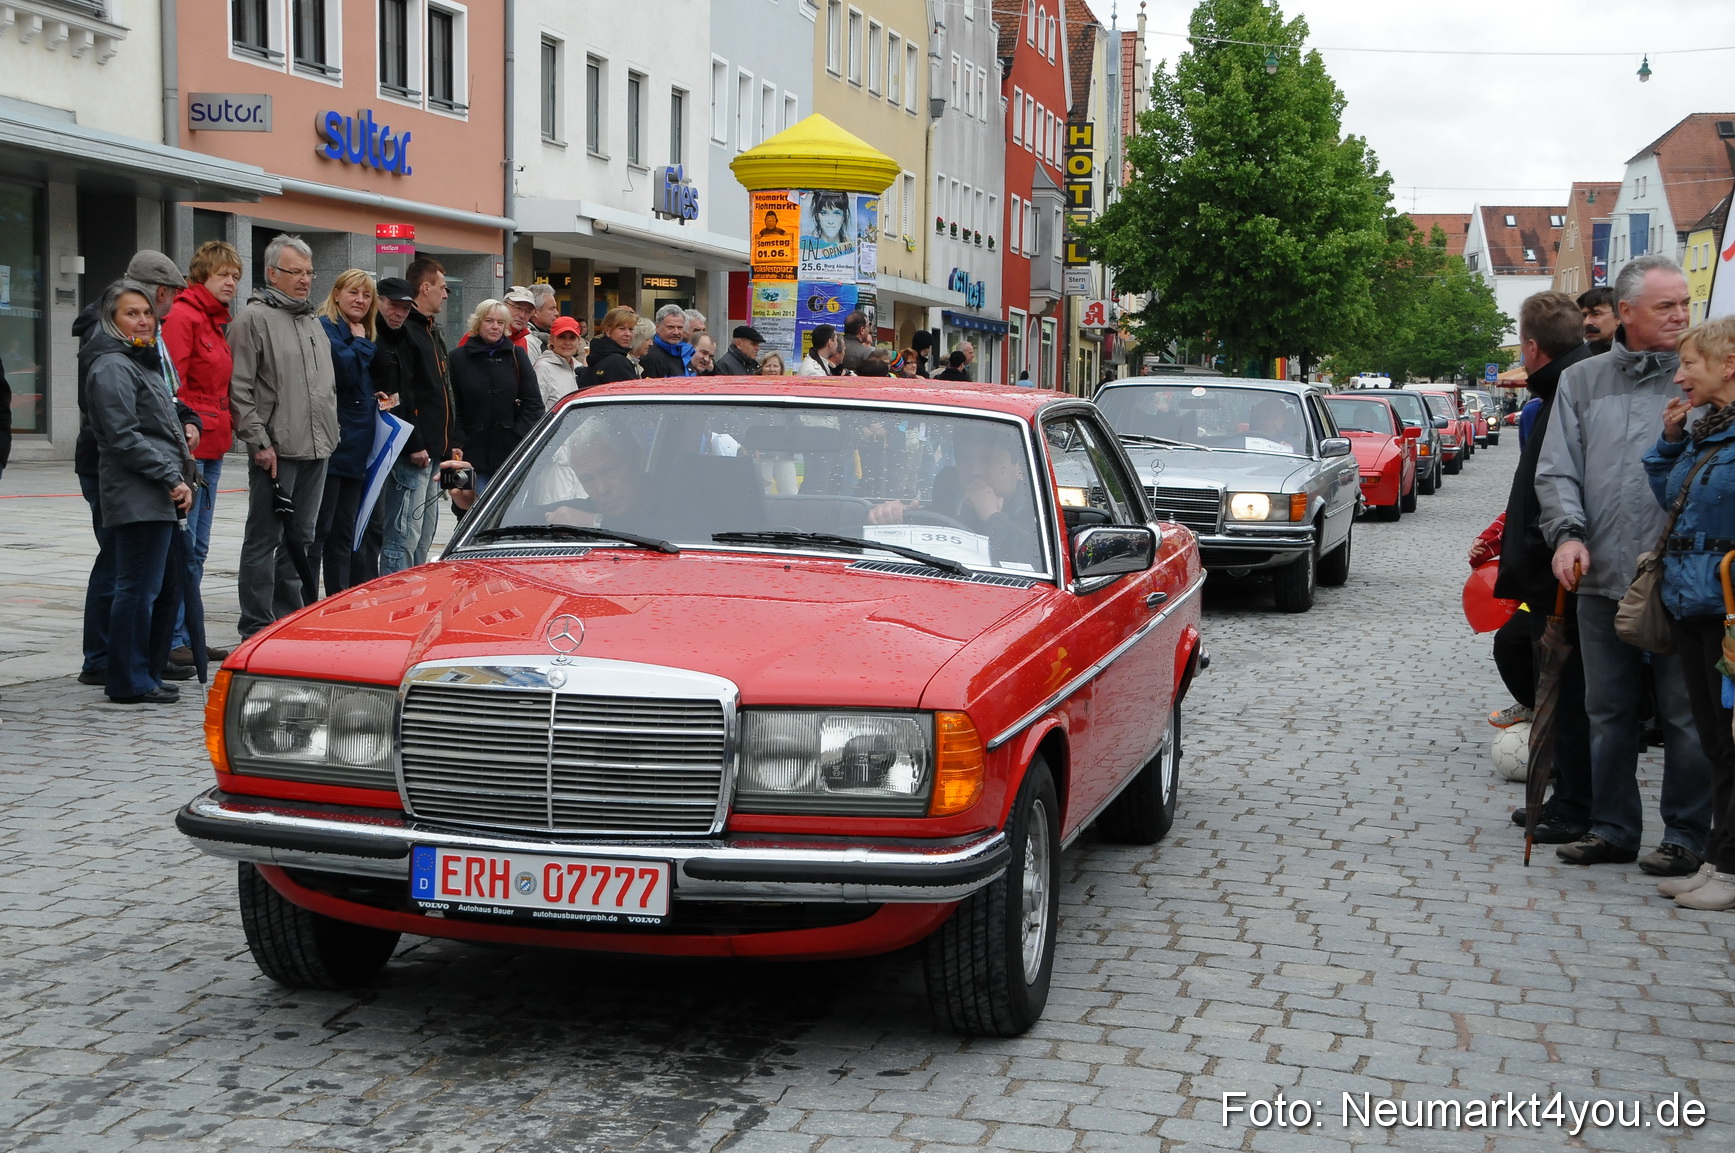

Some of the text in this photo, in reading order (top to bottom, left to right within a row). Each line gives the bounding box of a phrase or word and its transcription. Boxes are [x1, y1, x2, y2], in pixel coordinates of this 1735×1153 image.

[191, 99, 264, 123] sutor.
[324, 109, 413, 176] sutor.
[663, 164, 699, 220] fries
[757, 239, 790, 248] Samstag
[801, 238, 820, 261] ZAZ
[823, 247, 842, 259] OPEN
[844, 242, 854, 253] AIR
[757, 249, 788, 258] 01.06.
[801, 263, 824, 271] 25.6.
[644, 278, 678, 287] FRIES
[921, 533, 962, 545] 385
[420, 878, 429, 890] D
[442, 855, 659, 908] ERH 07777
[417, 901, 661, 924] VOLVO Autohaus Bauer autohausbauergmbh.de VOLVO
